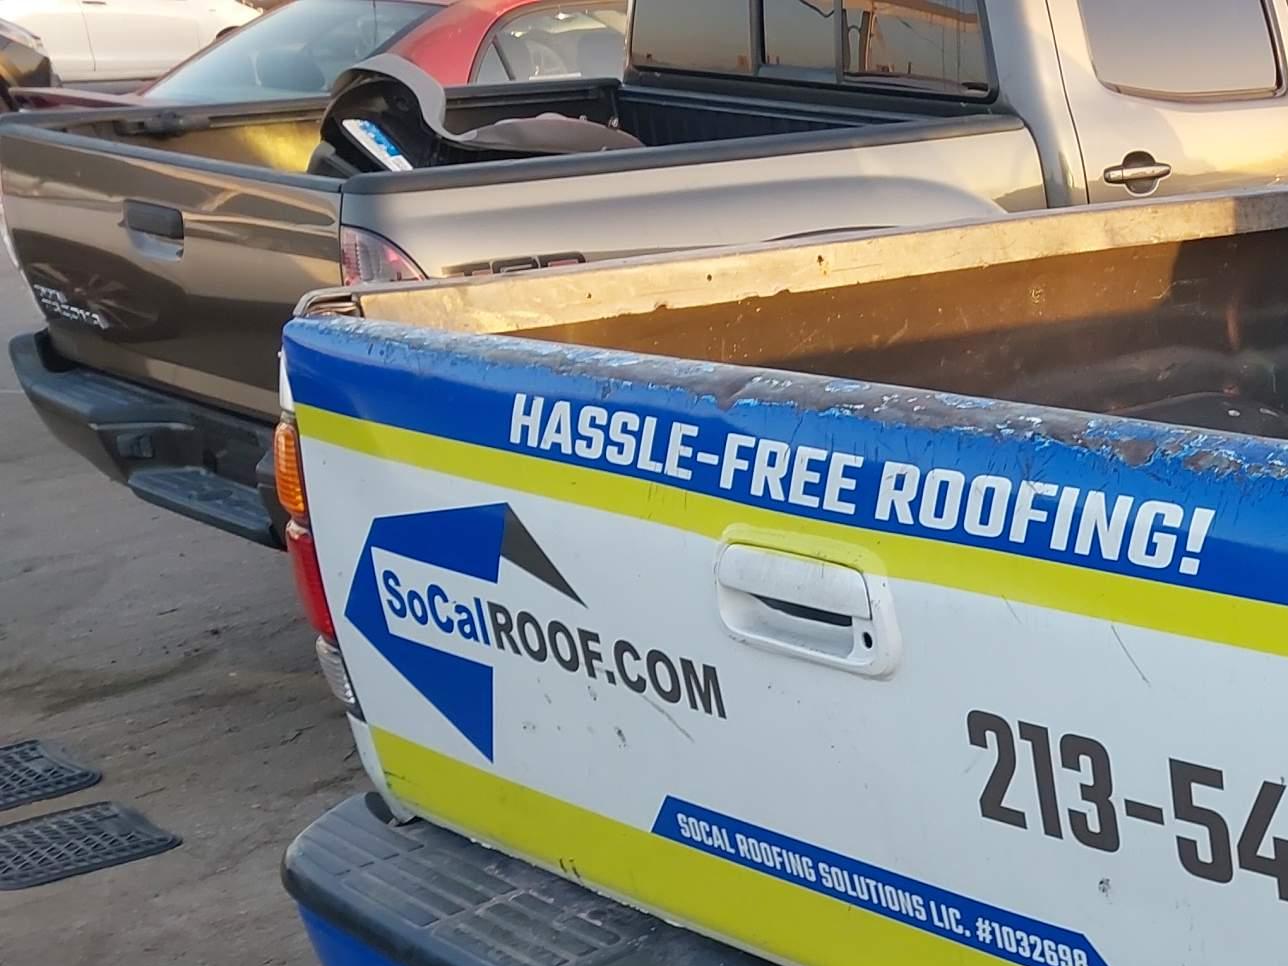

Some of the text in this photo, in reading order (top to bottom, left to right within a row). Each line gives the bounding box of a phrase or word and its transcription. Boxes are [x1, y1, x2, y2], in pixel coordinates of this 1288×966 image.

[509, 393, 1216, 575] HASSLE-FREE ROOFING!
[381, 569, 727, 719] SoCalROOF.COM
[676, 813, 735, 855] SOCAL
[735, 835, 815, 883] ROOFING
[818, 862, 927, 922] SOLUTIONS
[928, 900, 971, 938] LIC.
